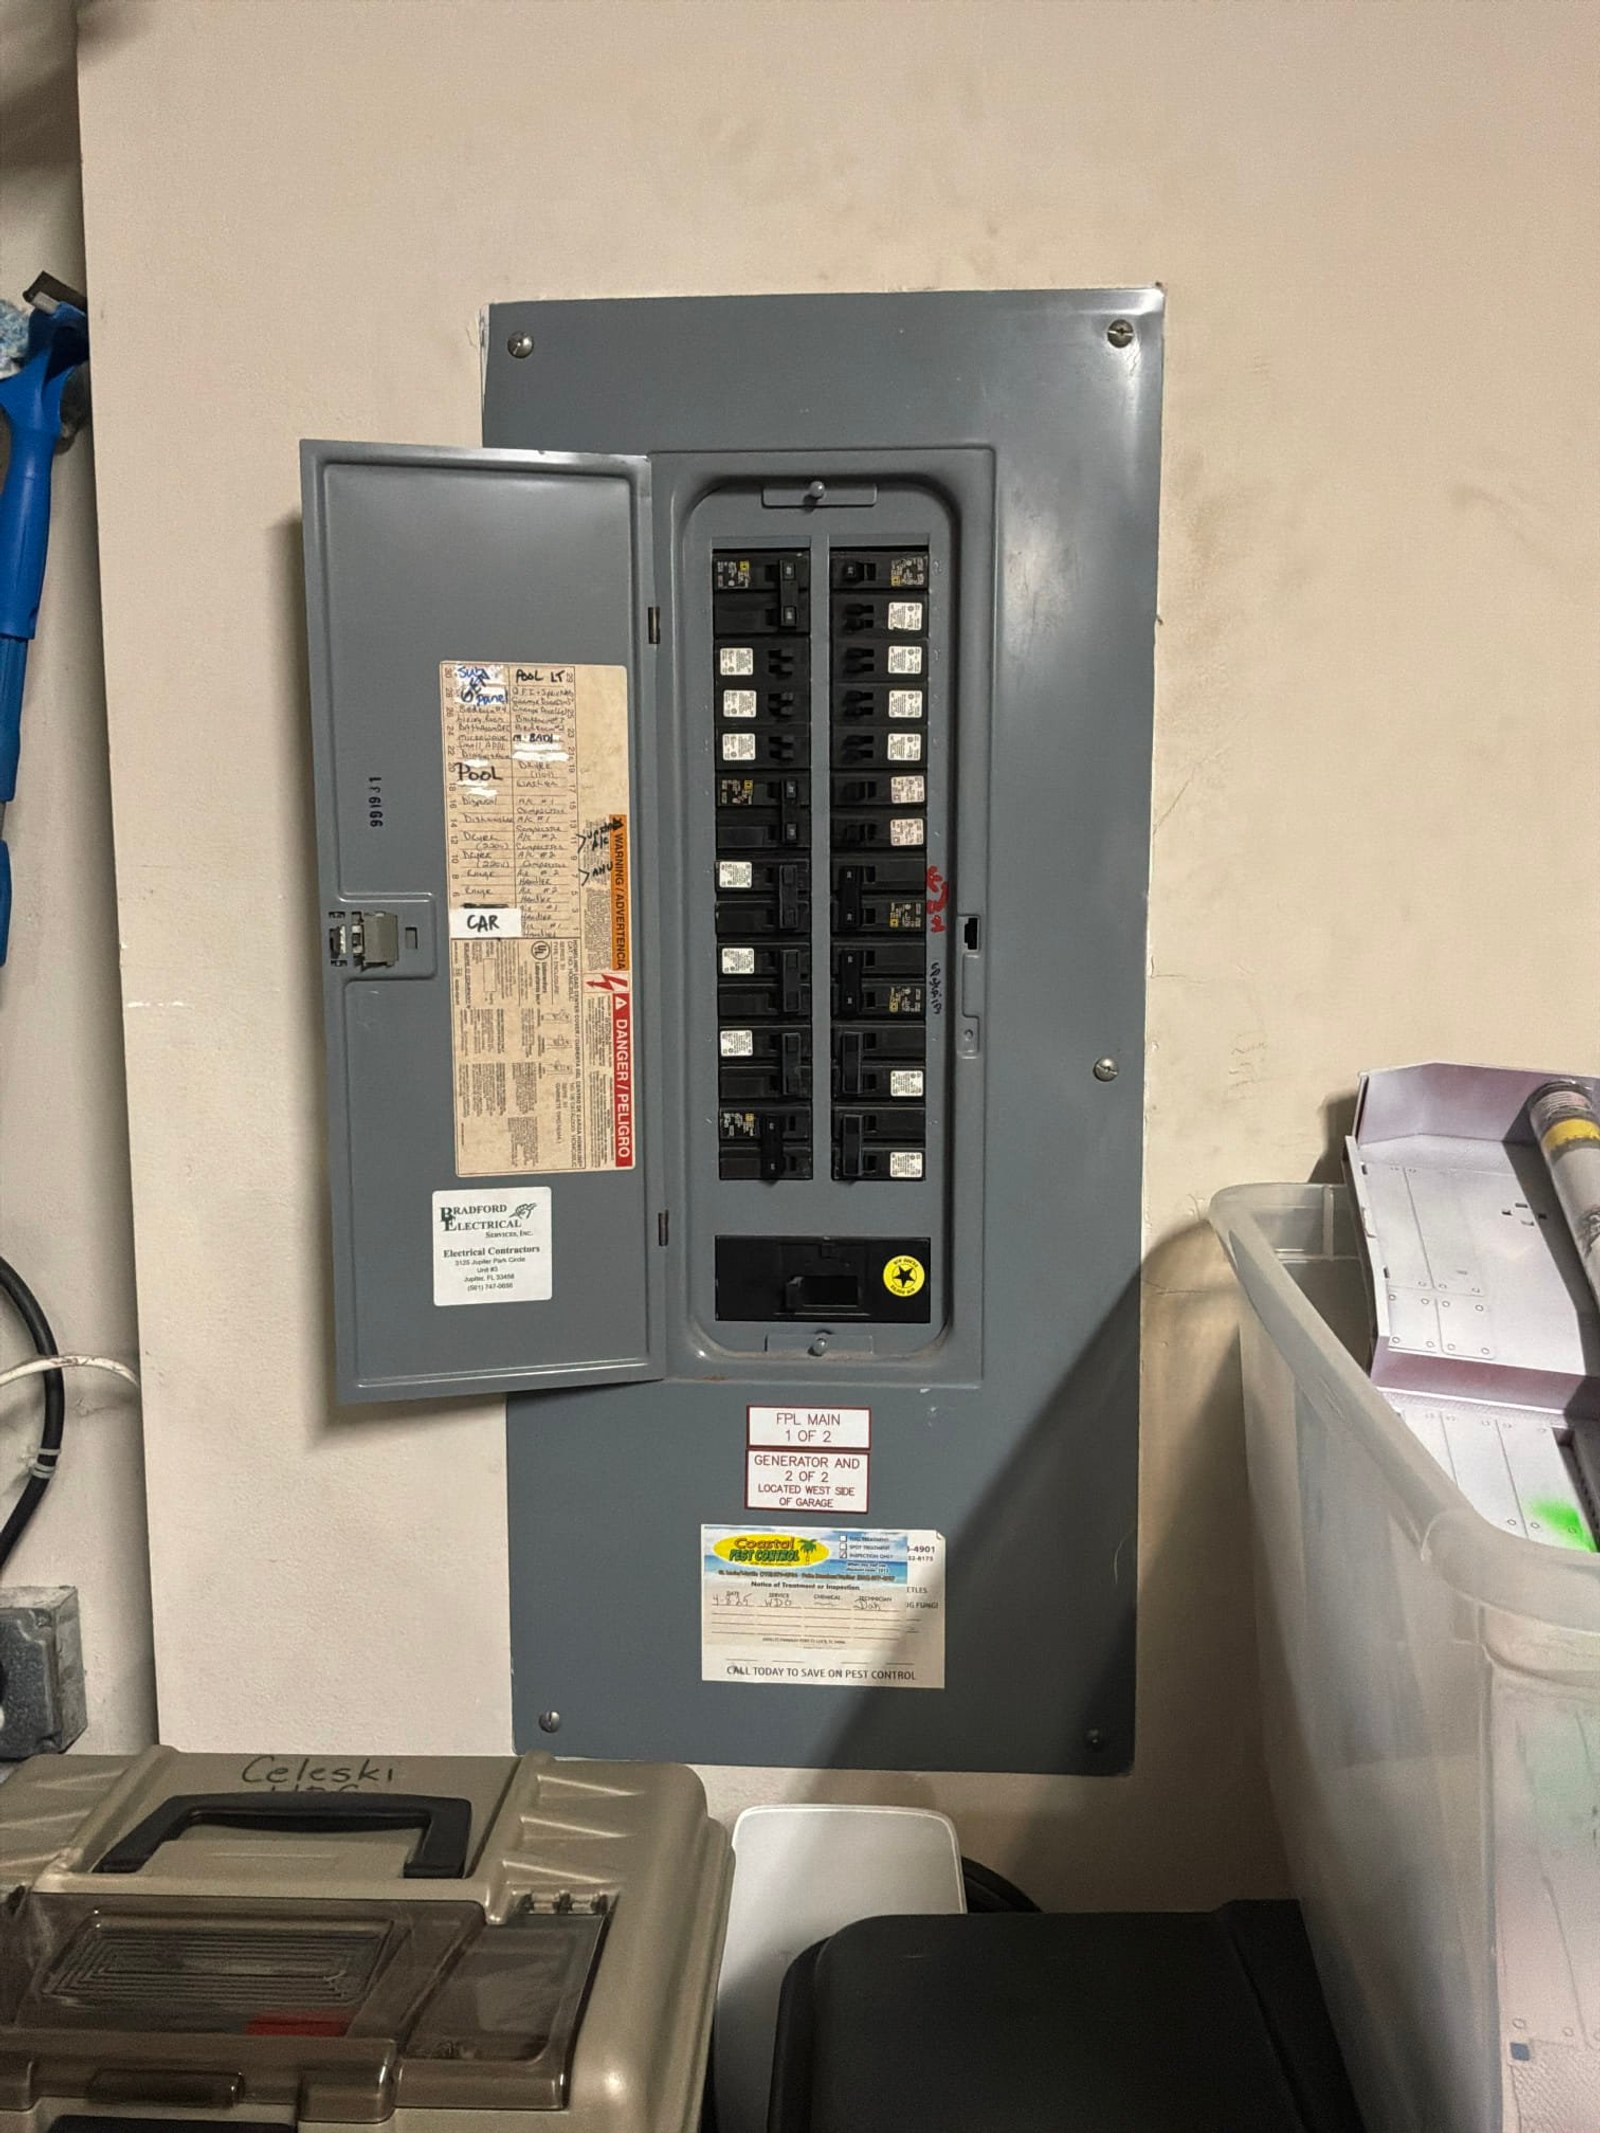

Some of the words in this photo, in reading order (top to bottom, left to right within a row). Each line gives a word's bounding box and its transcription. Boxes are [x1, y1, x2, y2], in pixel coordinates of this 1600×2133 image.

[516, 668, 544, 683] POOL
[550, 670, 566, 683] LT
[615, 833, 624, 886] WARNING
[466, 914, 500, 932] CAR
[616, 894, 626, 970] ADVERTENCIA
[616, 1018, 628, 1081] DANGER
[616, 1092, 630, 1158] PELIGRO
[440, 1204, 508, 1222] BRADFORD
[444, 1220, 522, 1232] ELECTRICAL
[444, 1248, 486, 1258] Electrical
[488, 1246, 540, 1256] Contractors
[776, 1412, 800, 1426] FPL
[808, 1414, 840, 1426] MAIN
[786, 1430, 791, 1442] 1
[798, 1430, 816, 1442] OF
[823, 1430, 832, 1442] 2
[754, 1454, 828, 1468] GENERATOR
[834, 1458, 860, 1470] AND
[785, 1470, 793, 1482] 2
[798, 1470, 815, 1482] OF
[821, 1472, 829, 1482] 2
[758, 1484, 801, 1494] LOCATED
[806, 1486, 831, 1496] WEST
[834, 1487, 856, 1496] SIDE
[779, 1497, 792, 1506] OF
[796, 1498, 834, 1508] GARAGE
[734, 1536, 796, 1550] Coastal
[729, 1548, 755, 1562] PEST
[755, 1550, 800, 1562] CONTROL
[726, 1664, 750, 1676] CALL
[754, 1666, 784, 1677] TODAY
[787, 1668, 798, 1677] TO
[801, 1668, 826, 1678] SAVE
[828, 1670, 842, 1678] ON
[846, 1670, 868, 1679] PEST
[872, 1670, 916, 1680] CONTROL
[241, 1755, 394, 1784] Celeski
